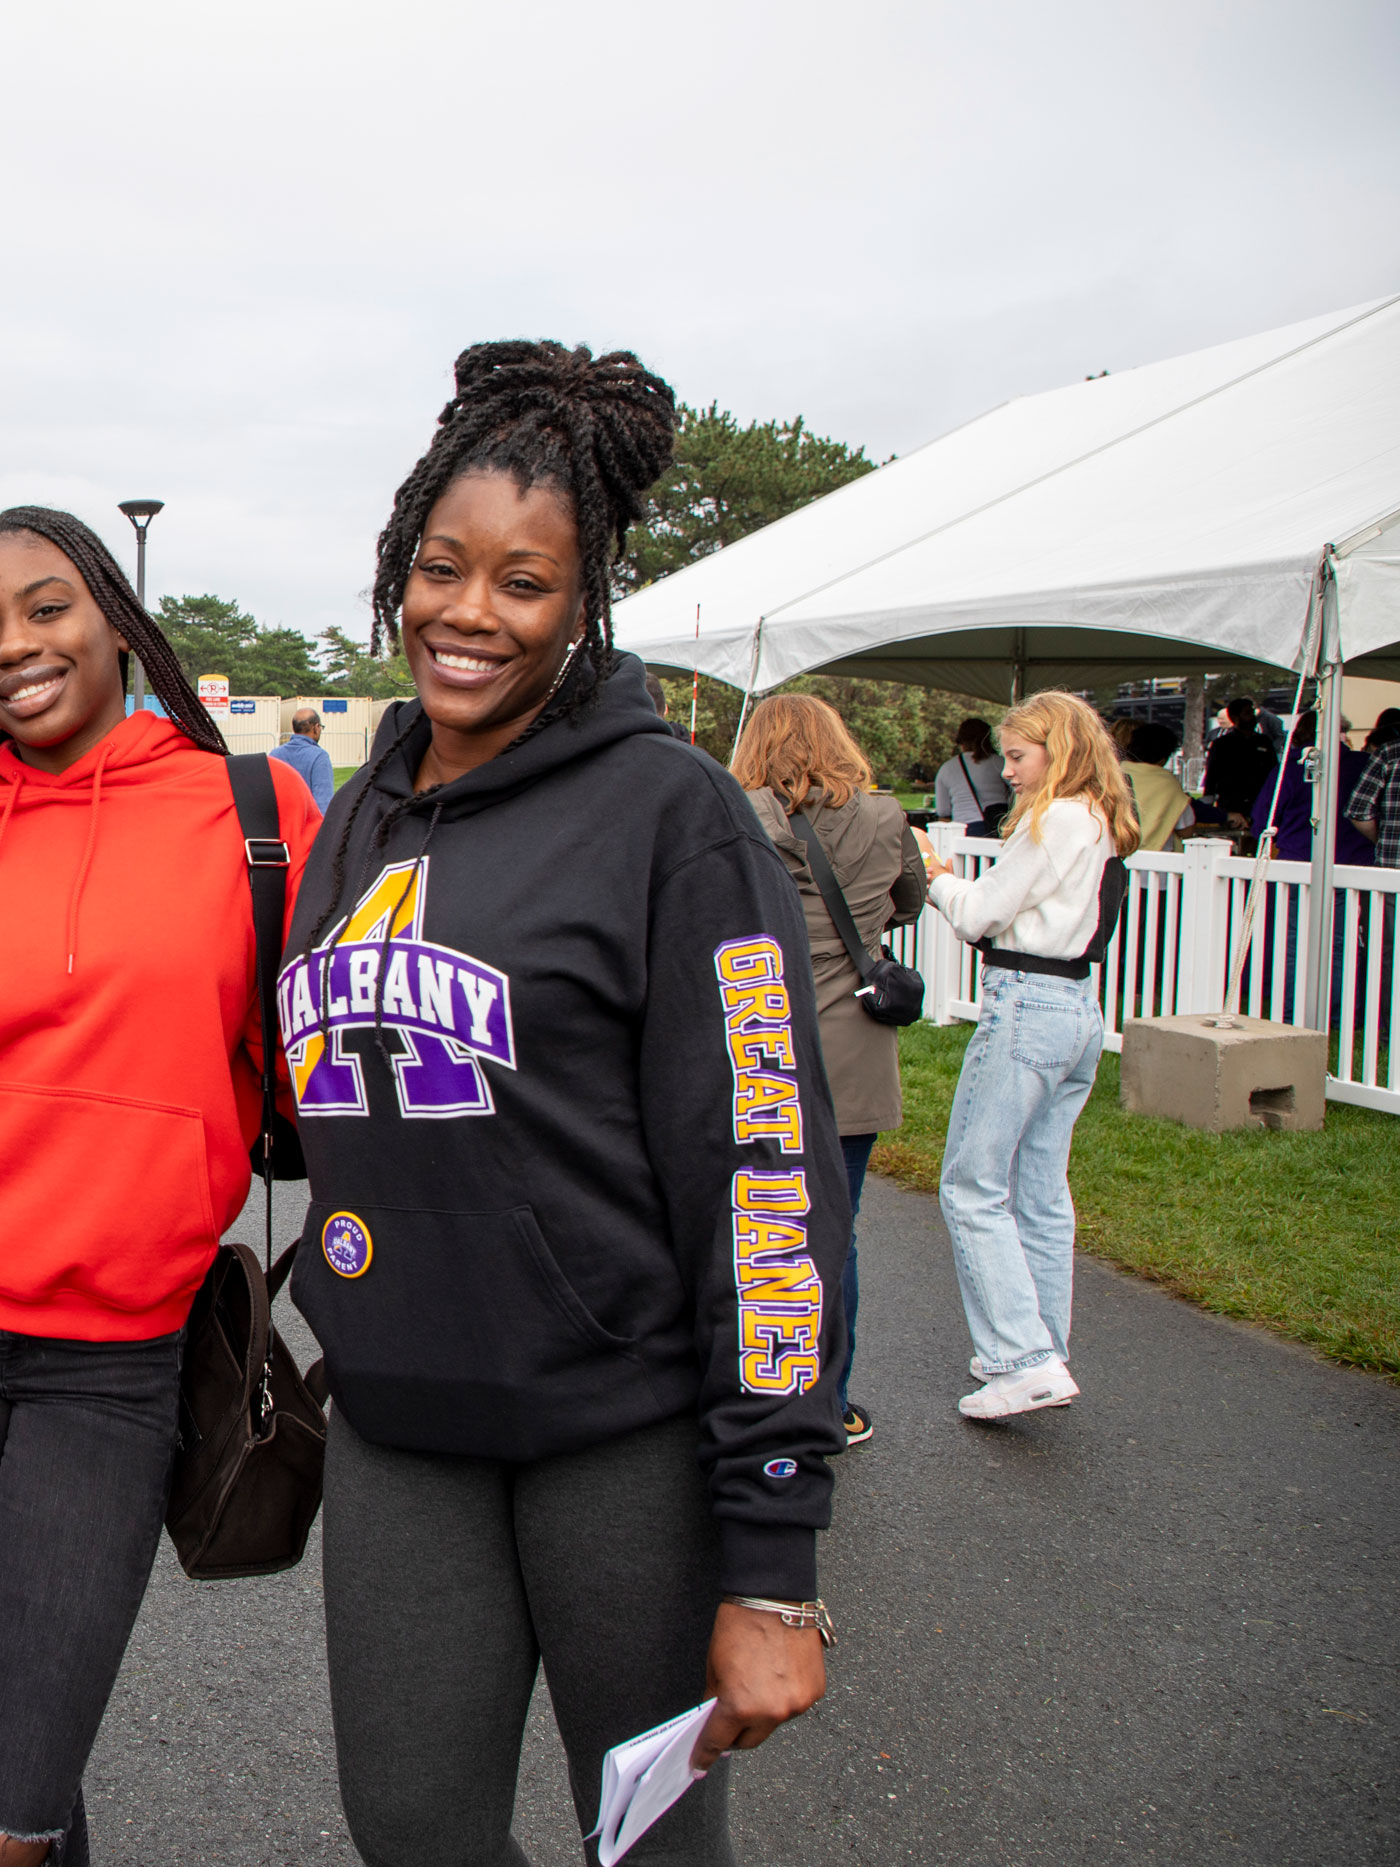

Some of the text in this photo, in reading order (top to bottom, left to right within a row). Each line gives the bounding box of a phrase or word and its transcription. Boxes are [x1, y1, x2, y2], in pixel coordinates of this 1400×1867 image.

[713, 933, 823, 1396] GREAT DANES
[334, 1219, 363, 1242] PROUD
[327, 1247, 358, 1271] PARENT
